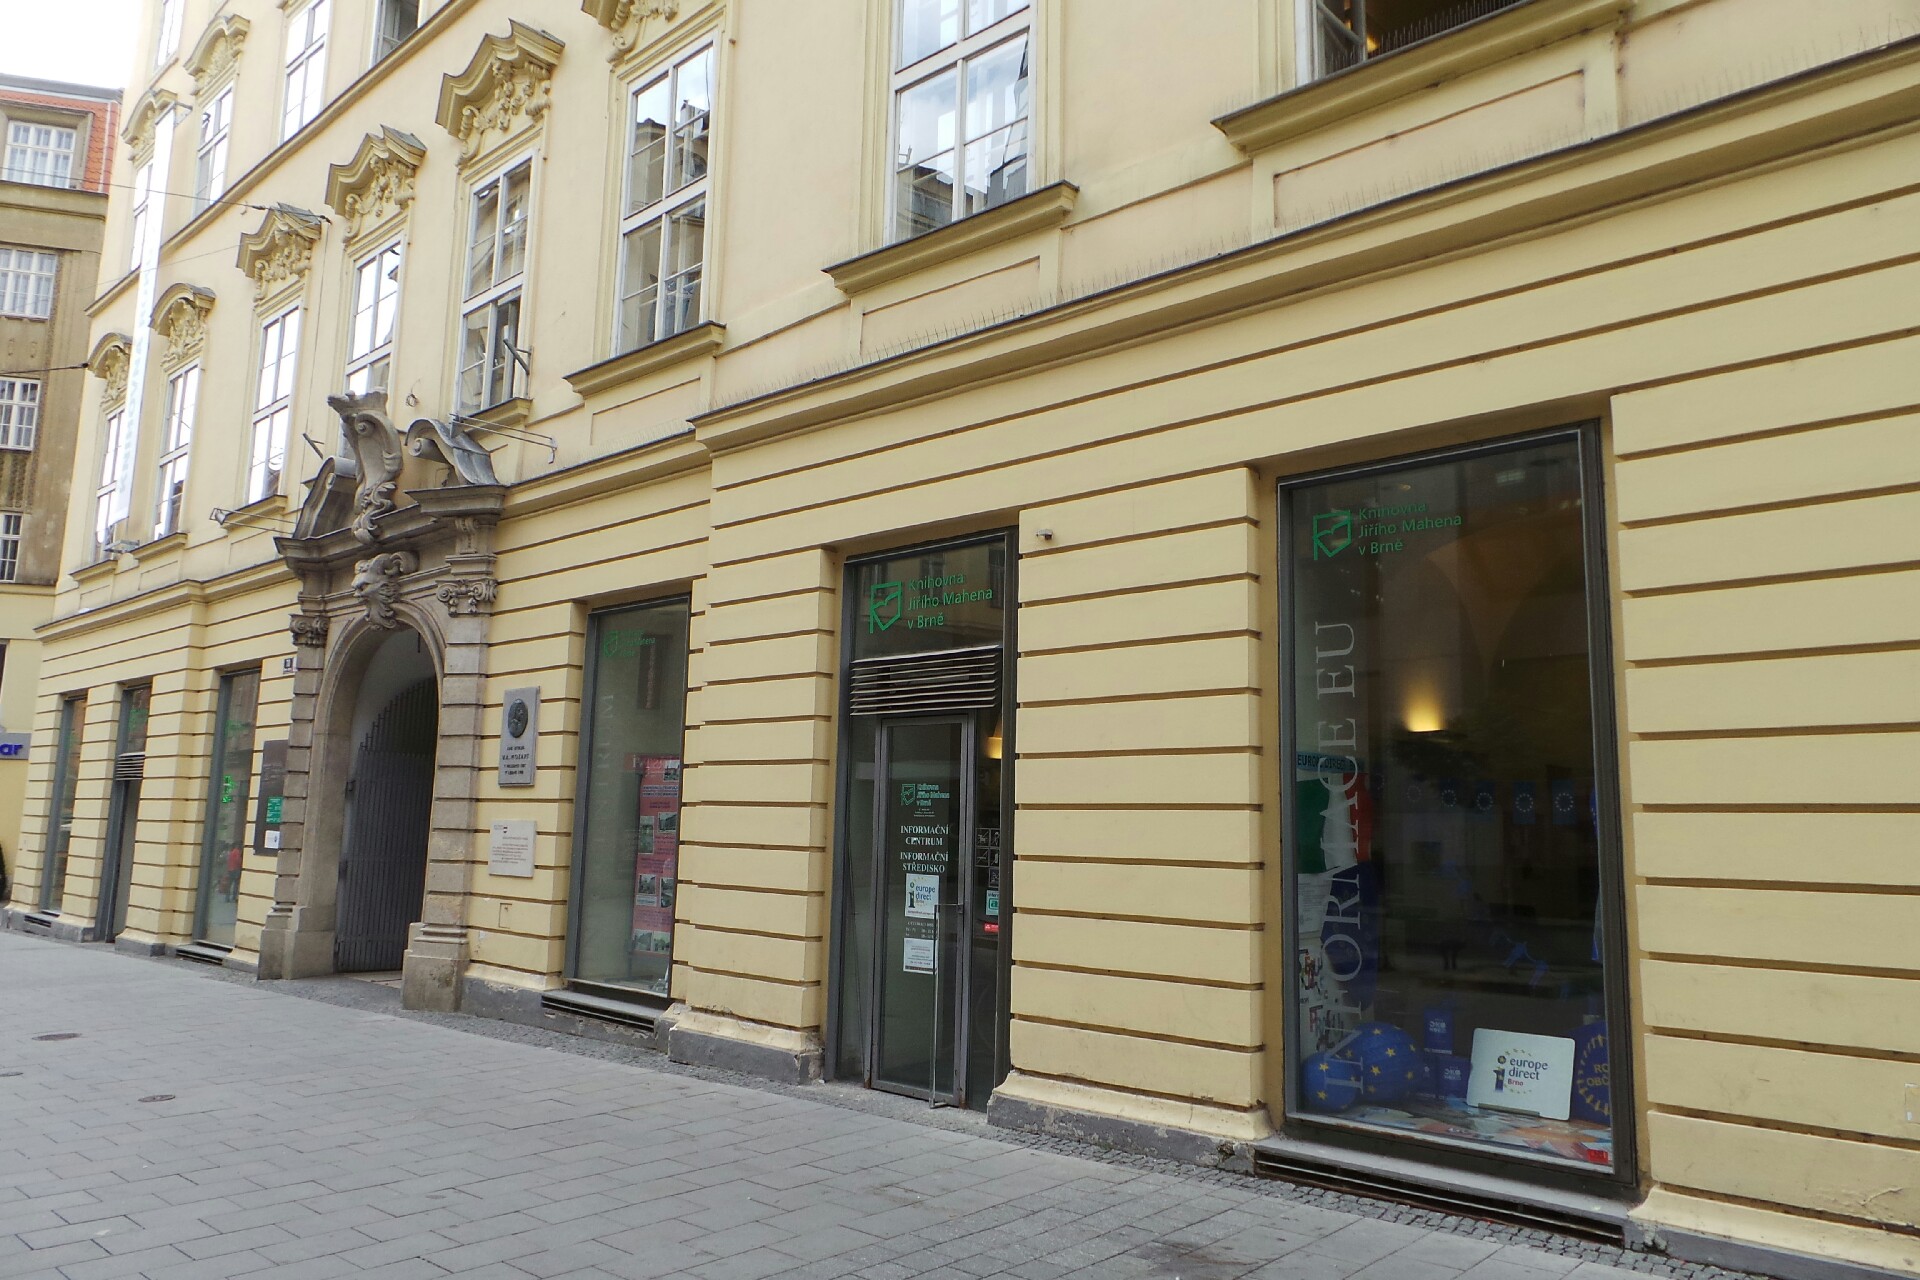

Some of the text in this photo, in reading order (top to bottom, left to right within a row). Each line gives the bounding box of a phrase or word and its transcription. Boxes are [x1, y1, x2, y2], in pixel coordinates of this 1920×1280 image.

[1359, 502, 1426, 520] Knihovna
[1359, 515, 1462, 538] Jiřího Mahena
[1358, 538, 1404, 555] v Brně
[908, 573, 964, 591] Knihovna
[908, 588, 993, 611] Jiřího Mahena
[907, 612, 944, 630] v Brně
[1314, 622, 1356, 698] EU
[900, 824, 949, 835] INFORMAČNÍ
[906, 837, 943, 846] CENTRUM
[900, 851, 949, 862] INFORMAČNÍ
[902, 862, 945, 873] STŘEDISKO
[915, 886, 936, 894] europe
[915, 893, 932, 901] direct
[1317, 718, 1364, 1094] INFORMACE
[1509, 1058, 1549, 1071] europe
[1508, 1067, 1540, 1080] direct
[1507, 1078, 1524, 1087] Brno
